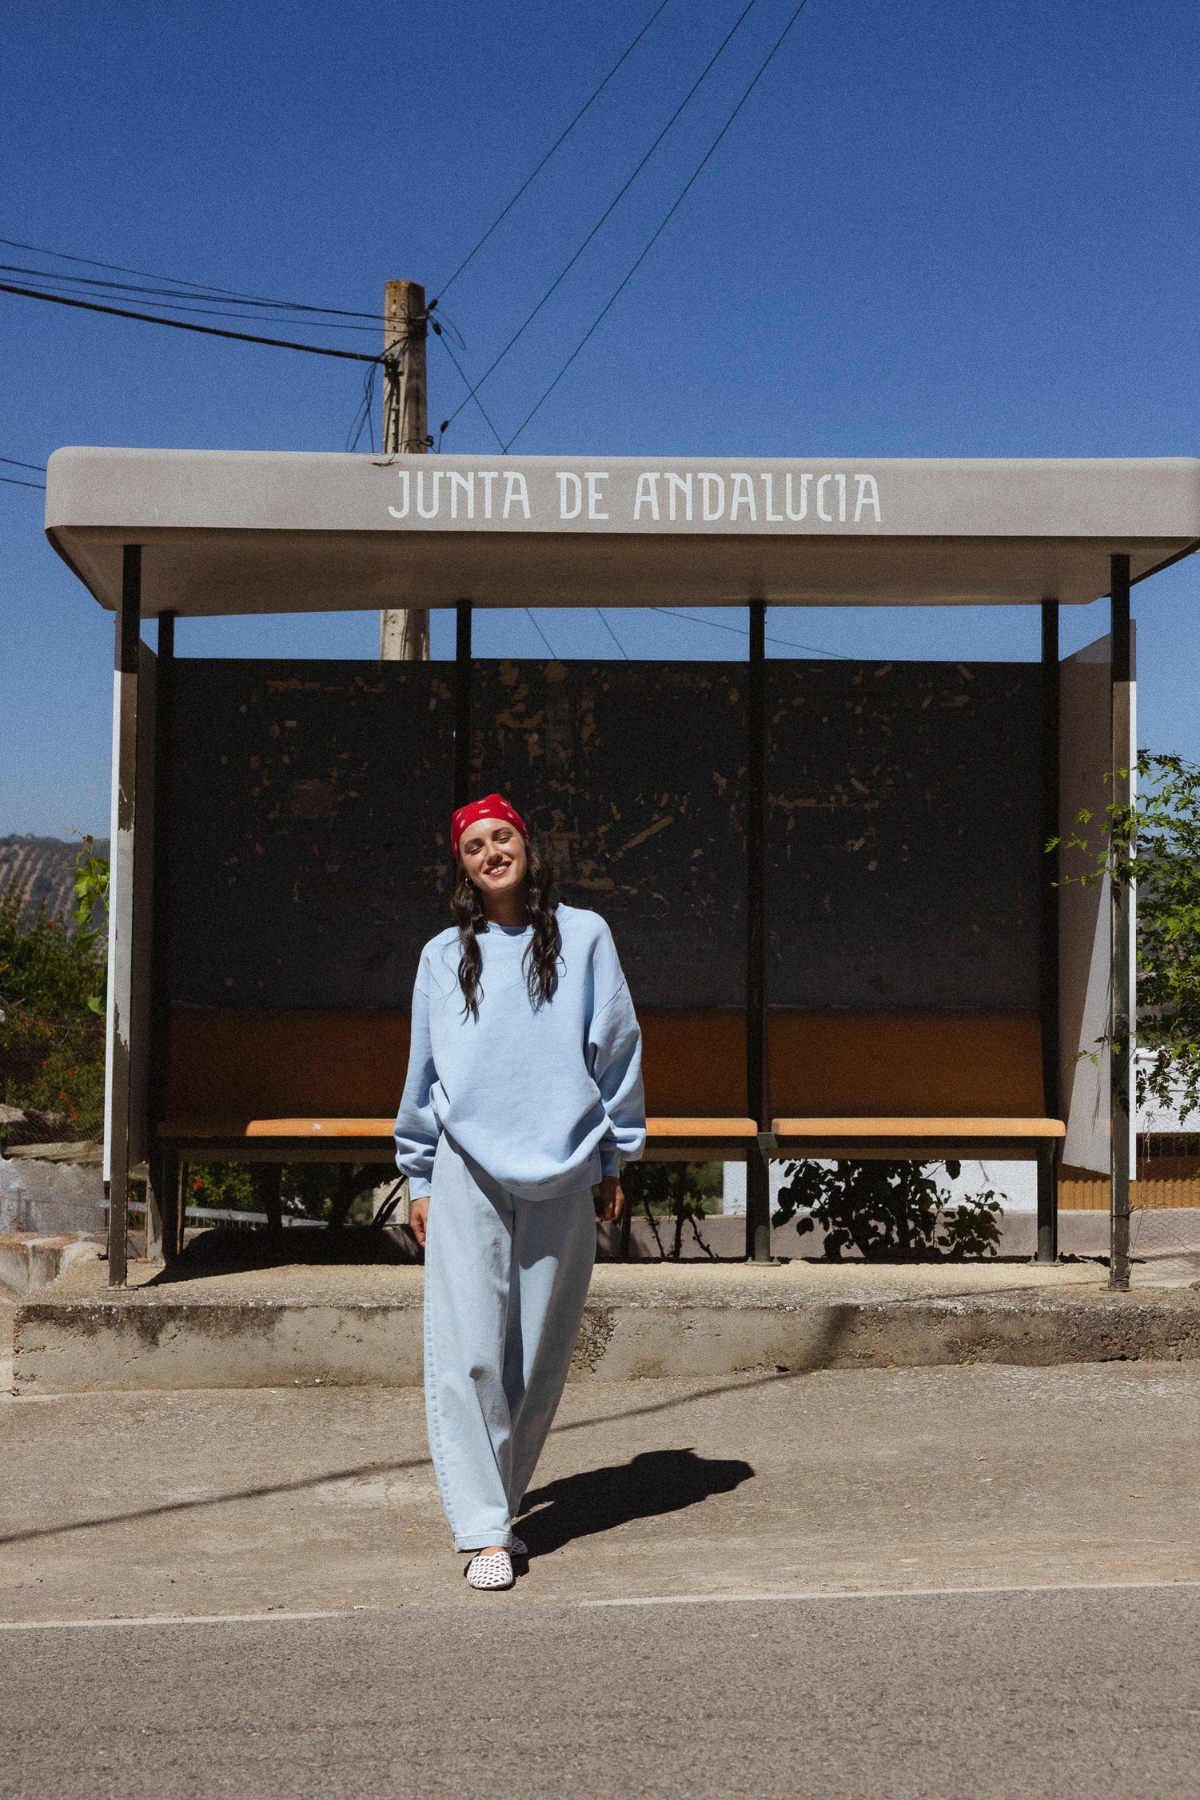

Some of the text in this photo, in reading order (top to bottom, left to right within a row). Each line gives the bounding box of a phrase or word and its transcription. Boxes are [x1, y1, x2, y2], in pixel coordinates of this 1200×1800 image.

[388, 471, 882, 523] JUNTA DE ANDALUCIA
